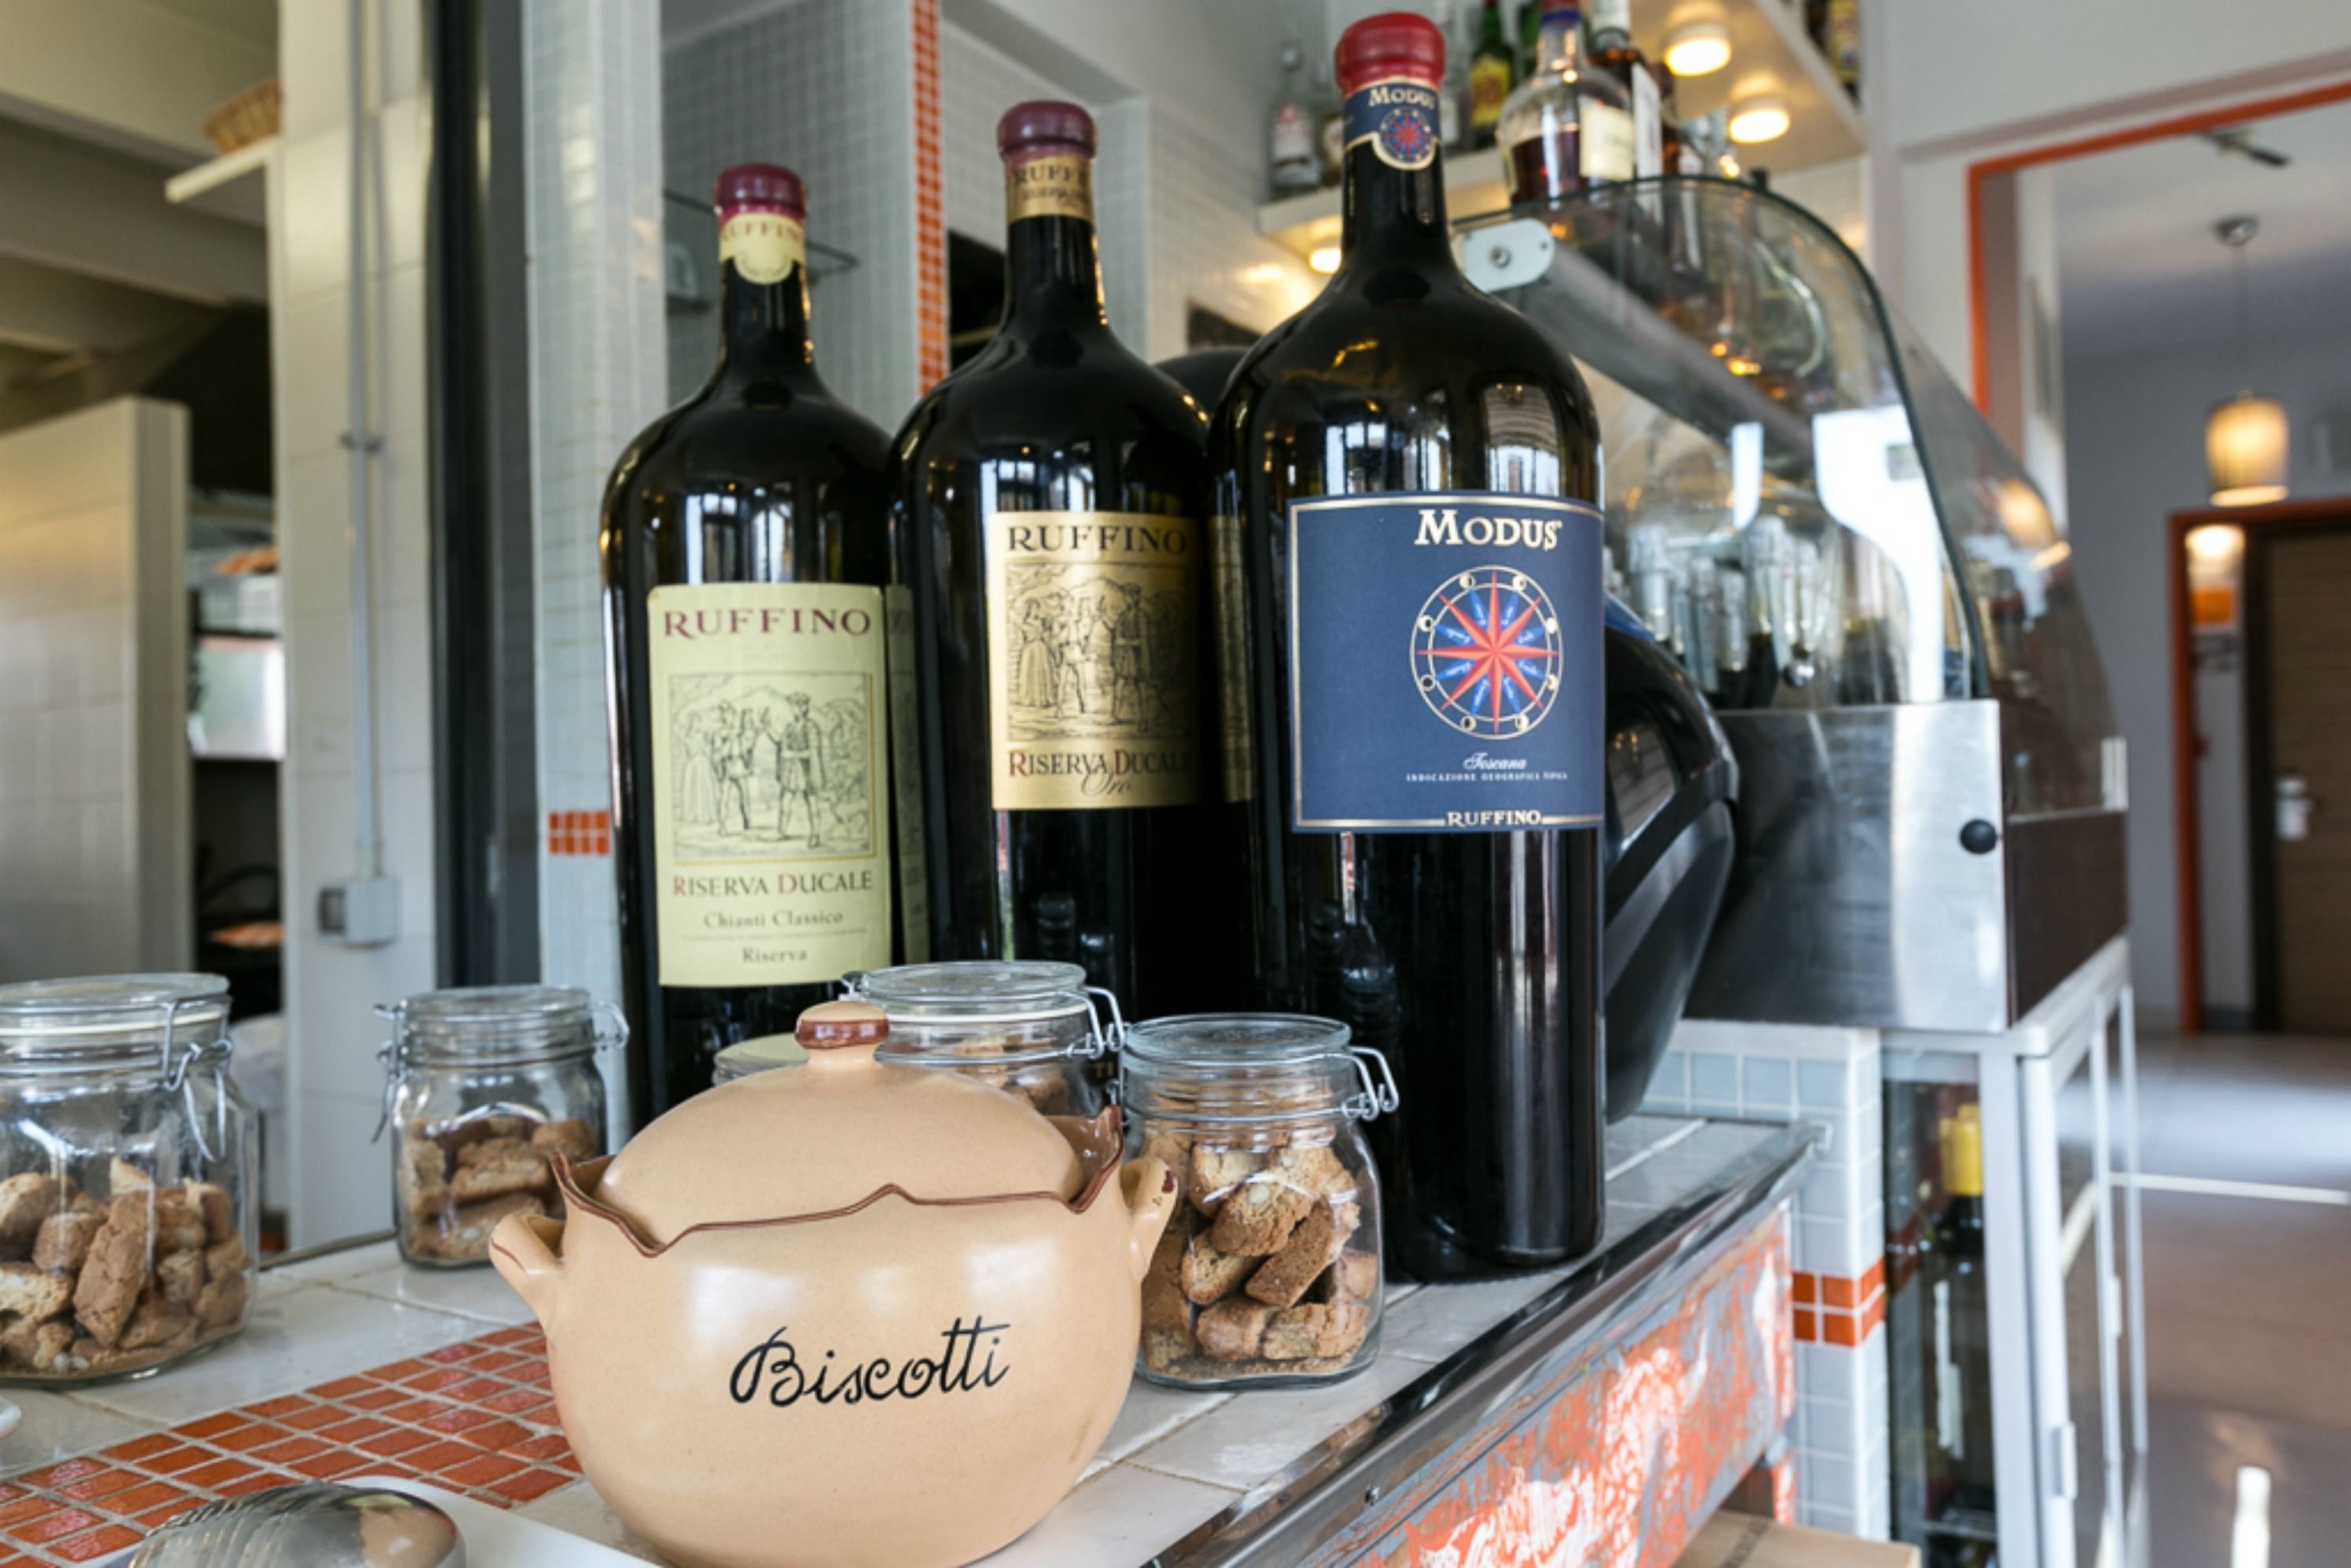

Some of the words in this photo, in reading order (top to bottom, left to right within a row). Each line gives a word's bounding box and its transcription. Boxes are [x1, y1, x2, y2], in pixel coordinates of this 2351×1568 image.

[1009, 525, 1187, 551] RUFFINO
[663, 607, 872, 640] RUFFINO
[1009, 749, 1108, 776] RISERVA
[1463, 752, 1528, 770] Toscana
[1445, 809, 1543, 827] RUFFINO
[673, 875, 769, 896] RISERVA
[778, 870, 873, 894] DUCALE
[704, 912, 766, 928] Chianti
[773, 908, 843, 926] Classico
[742, 946, 806, 963] Riserva
[730, 1316, 1011, 1407] Biscotti
